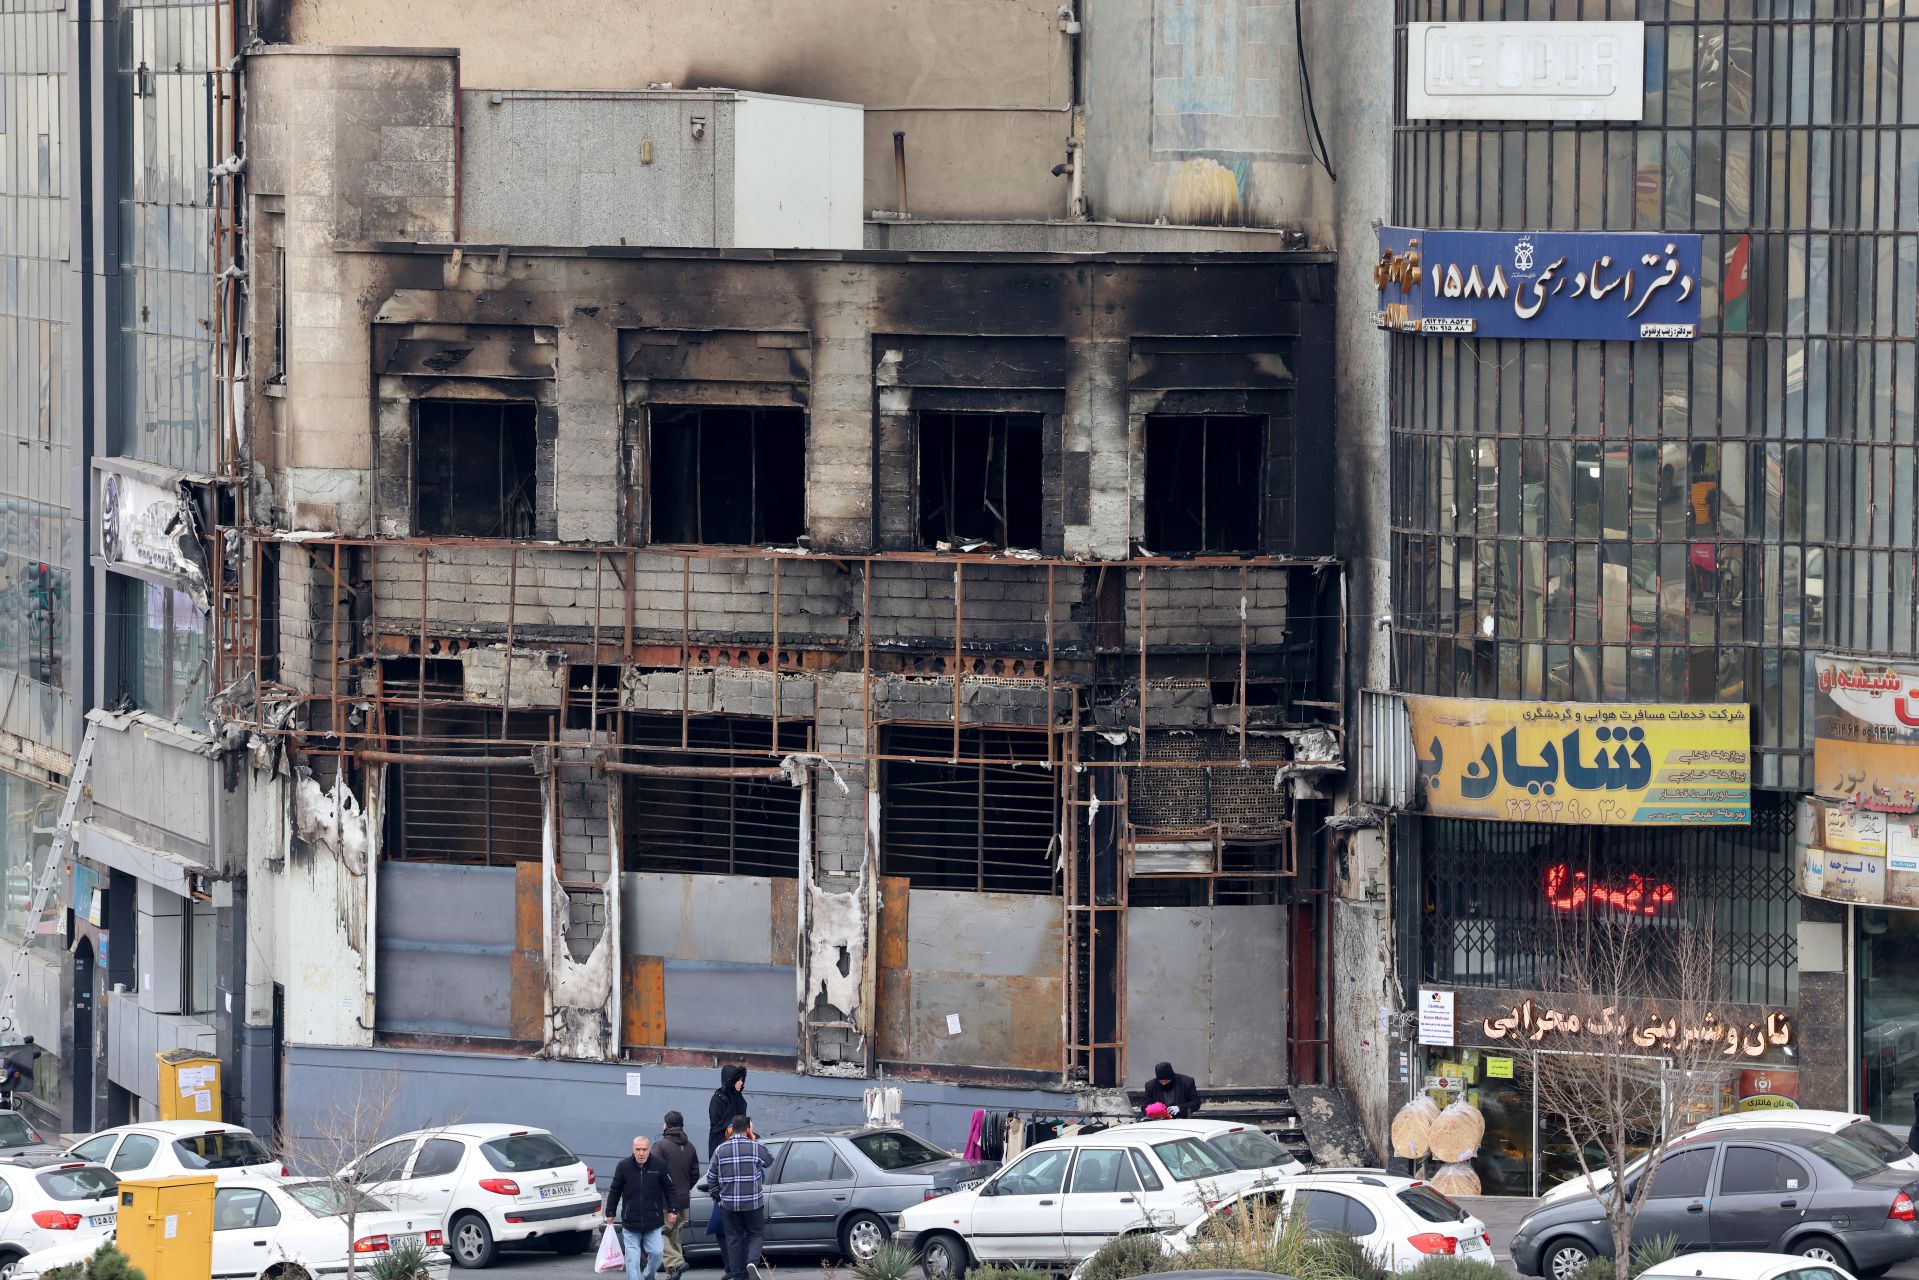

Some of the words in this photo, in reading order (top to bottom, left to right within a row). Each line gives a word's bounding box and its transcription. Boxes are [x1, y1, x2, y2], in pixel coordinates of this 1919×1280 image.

[1432, 264, 1509, 299] ۱۵۸۸
[1514, 256, 1566, 319] رسمی
[1570, 255, 1635, 300] اسناد
[1627, 243, 1695, 319] دفتر
[1522, 707, 1572, 722] گردشگری
[1575, 711, 1581, 722] و
[1584, 708, 1616, 722] هوایی
[1619, 709, 1665, 721] مسافرت
[1668, 708, 1705, 721] خدمات
[1709, 708, 1745, 722] شرکت
[1461, 726, 1653, 799] شایان
[1483, 998, 1580, 1041] محرابی
[1743, 1011, 1789, 1056] نان
[1723, 1026, 1740, 1055] و
